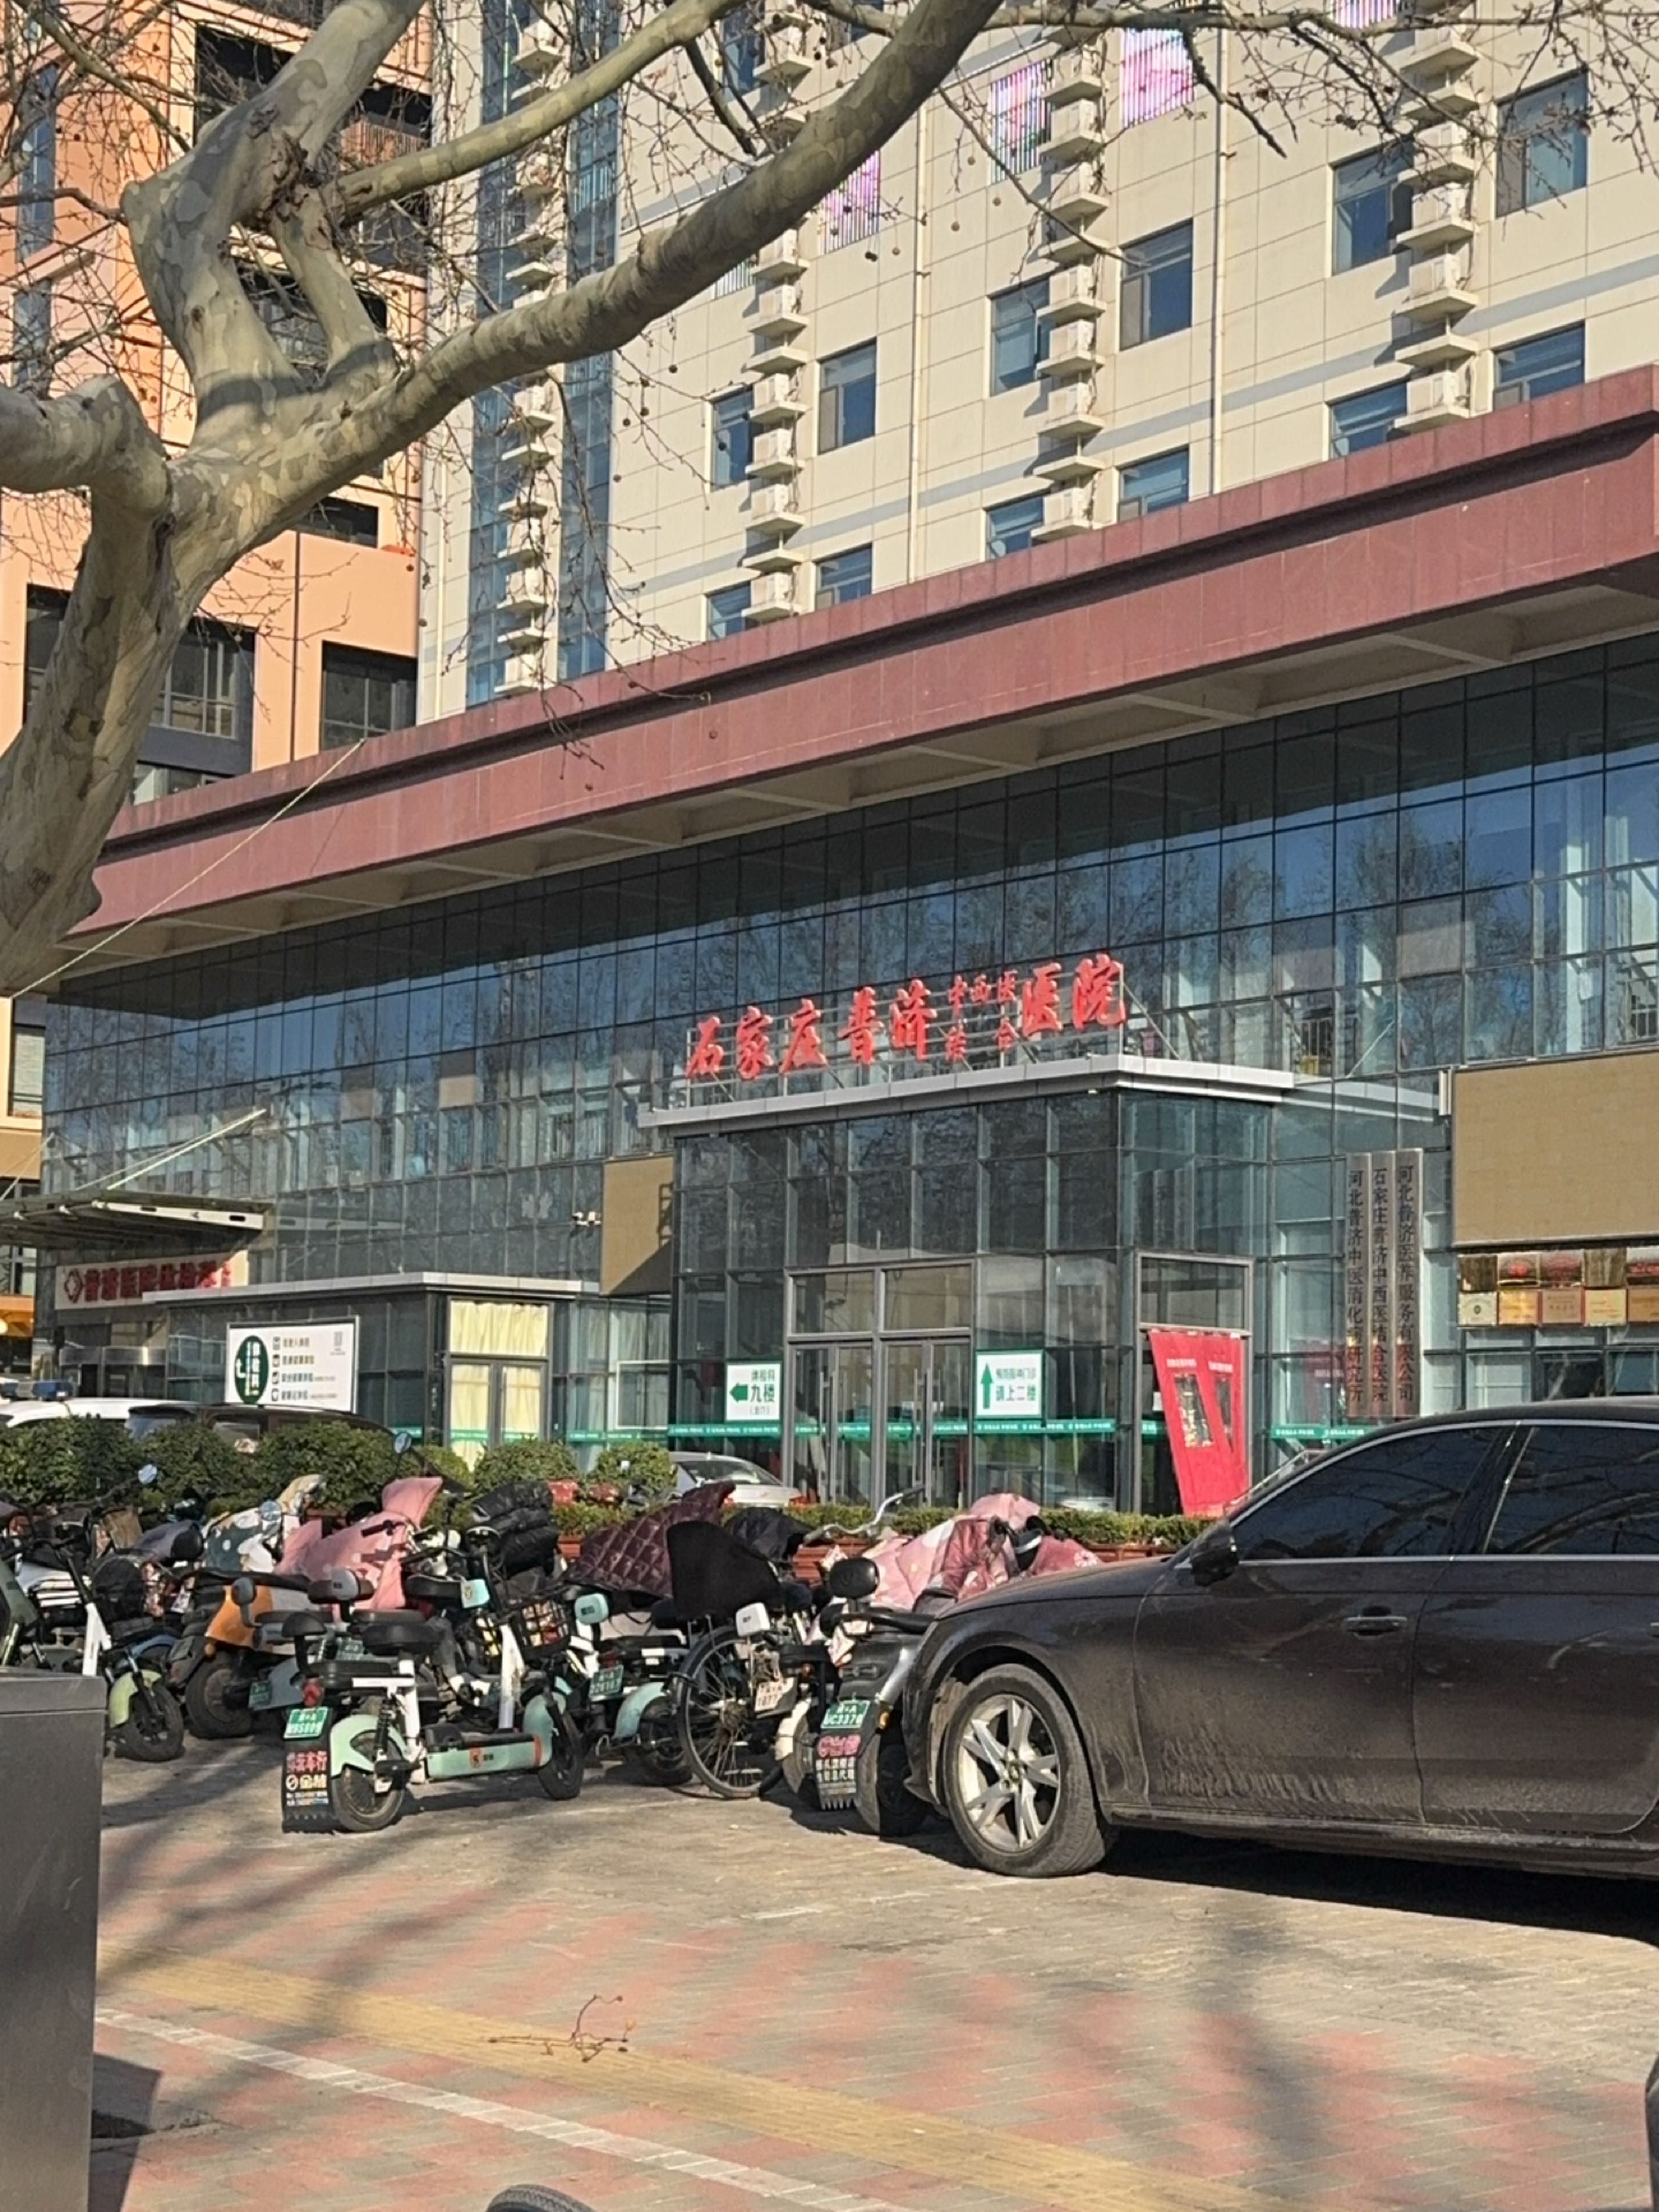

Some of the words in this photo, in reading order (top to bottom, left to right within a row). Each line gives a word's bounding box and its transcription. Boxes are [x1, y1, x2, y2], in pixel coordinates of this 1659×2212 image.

[1020, 952, 1126, 1037] 医院
[1371, 1167, 1389, 1402] 石家庄普济中西医结合医院
[750, 1383, 775, 1402] 九楼
